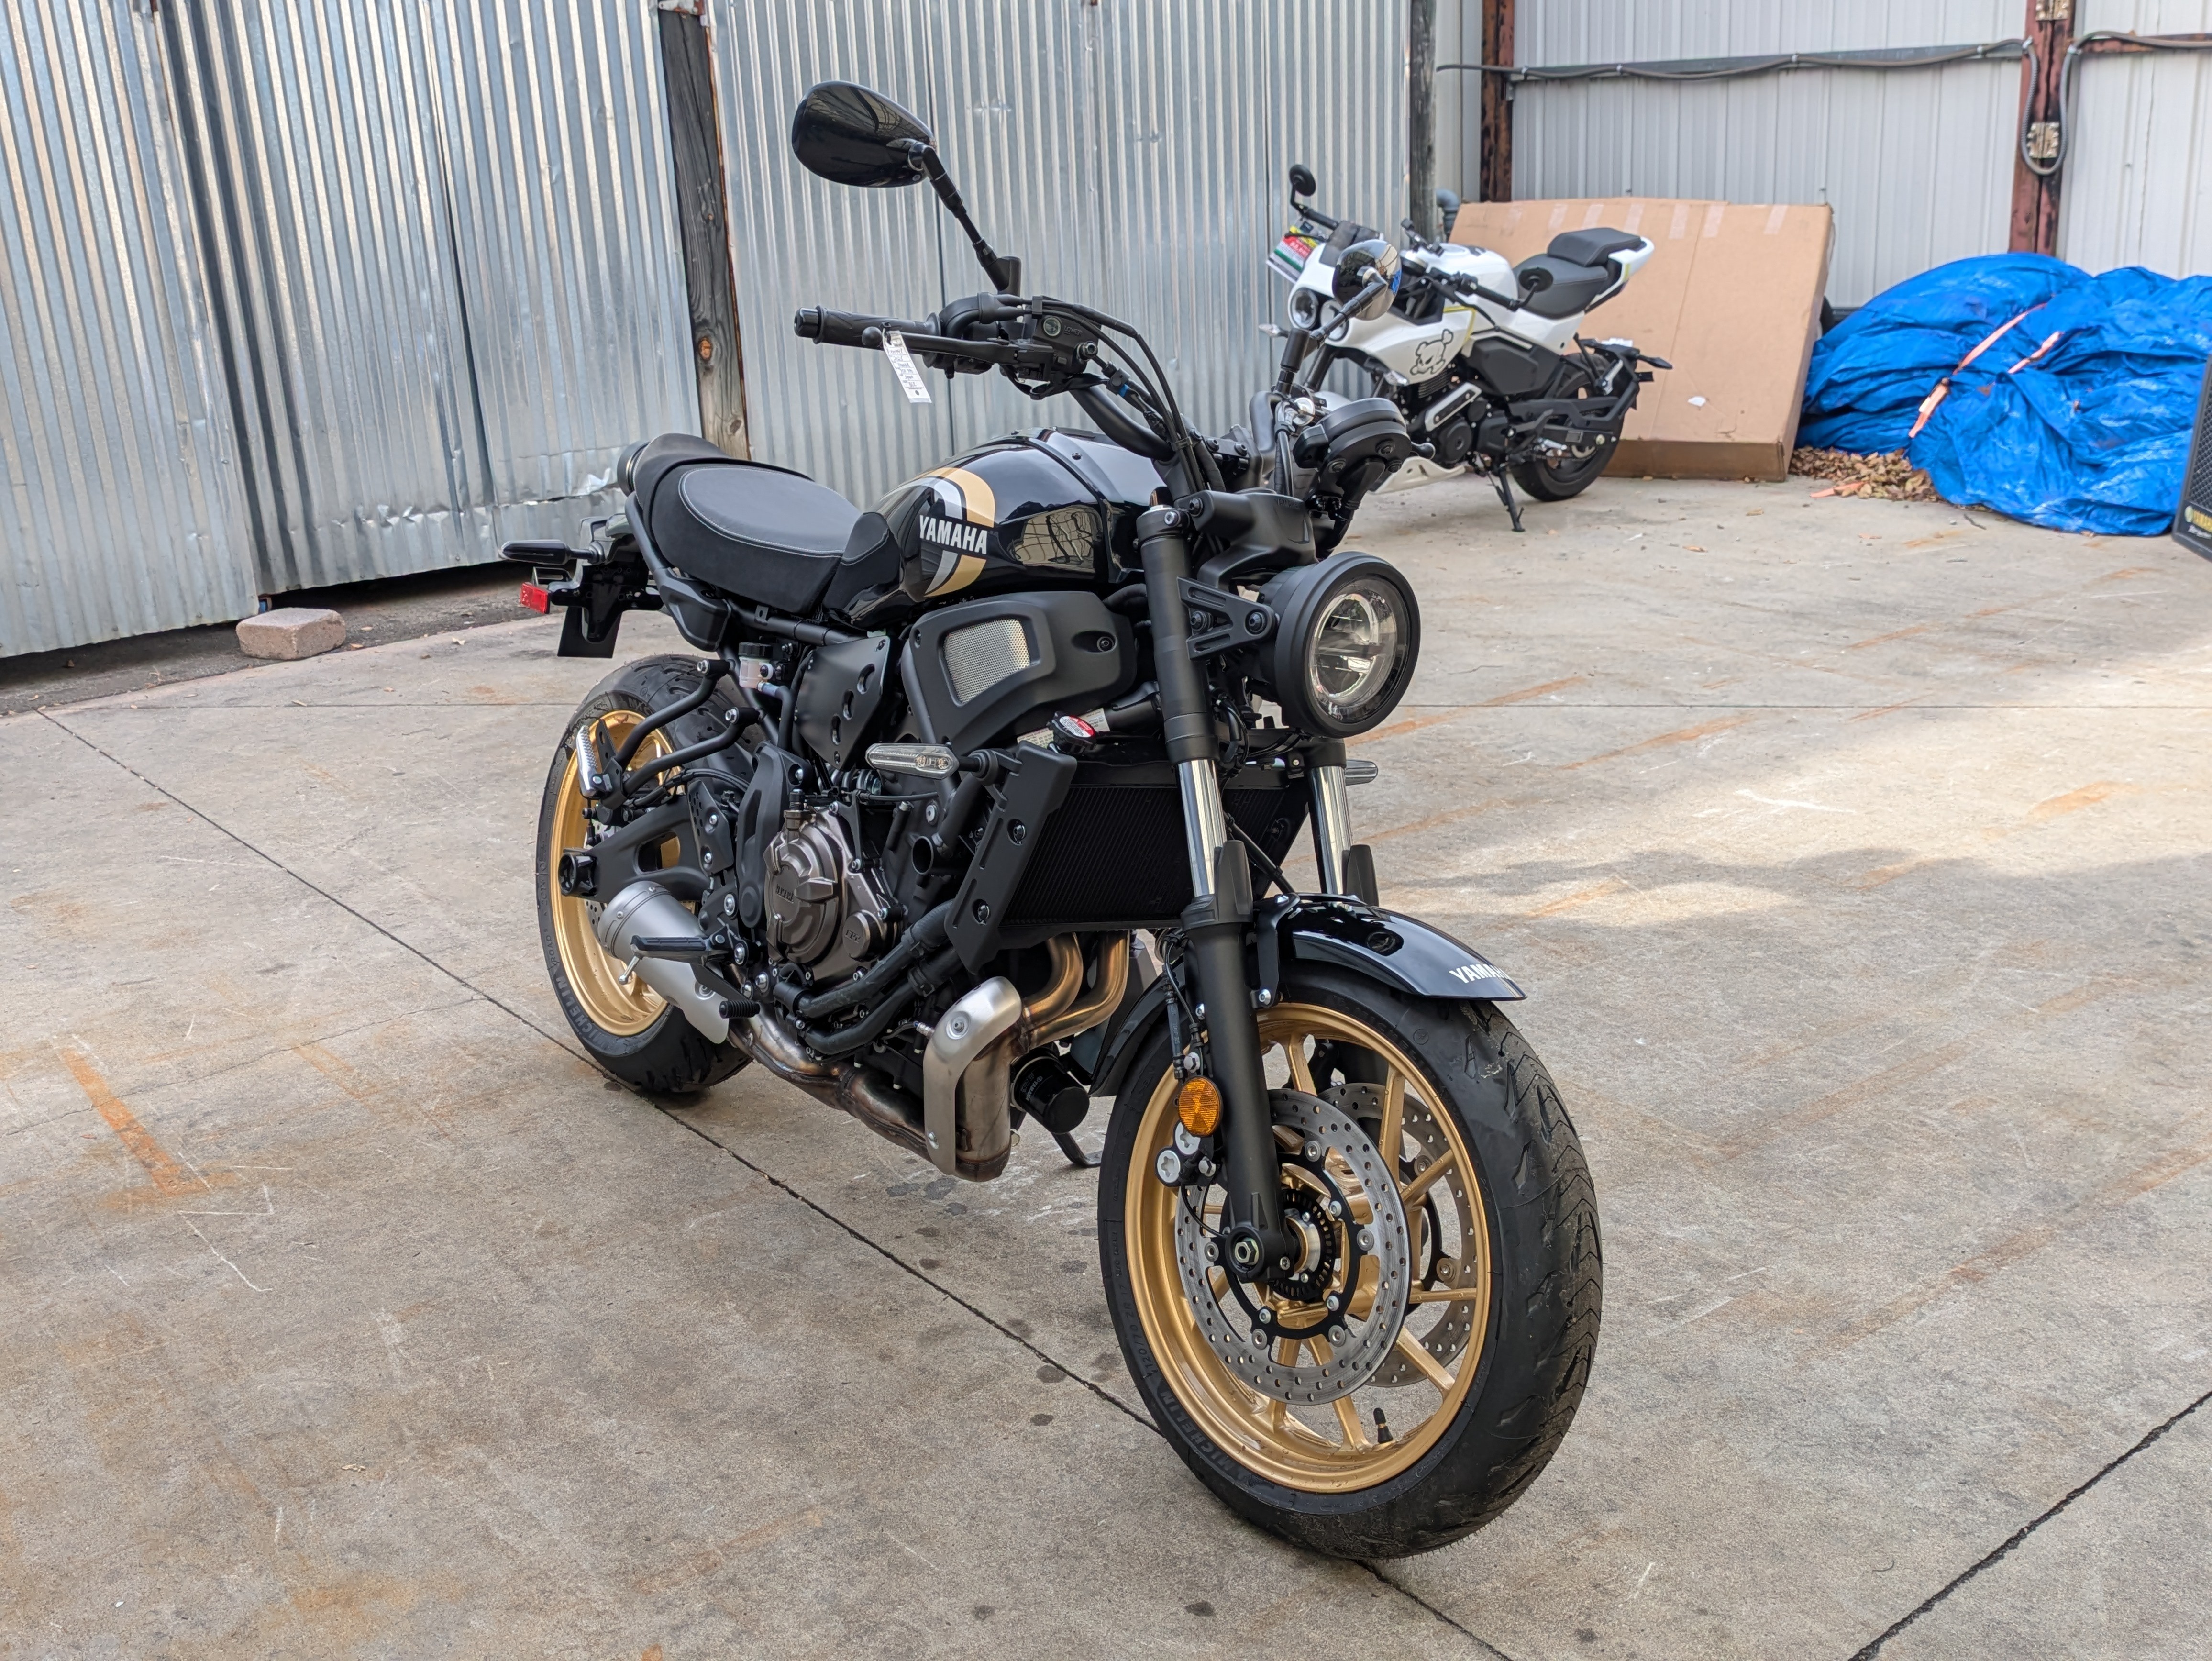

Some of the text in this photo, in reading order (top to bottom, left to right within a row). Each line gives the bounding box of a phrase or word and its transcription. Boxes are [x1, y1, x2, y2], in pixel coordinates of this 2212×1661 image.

[1063, 325, 1083, 336] LOWER
[919, 514, 988, 555] YAMAHA
[556, 976, 605, 1046] MICHELIN
[1160, 1390, 1236, 1472] MICHELIN
